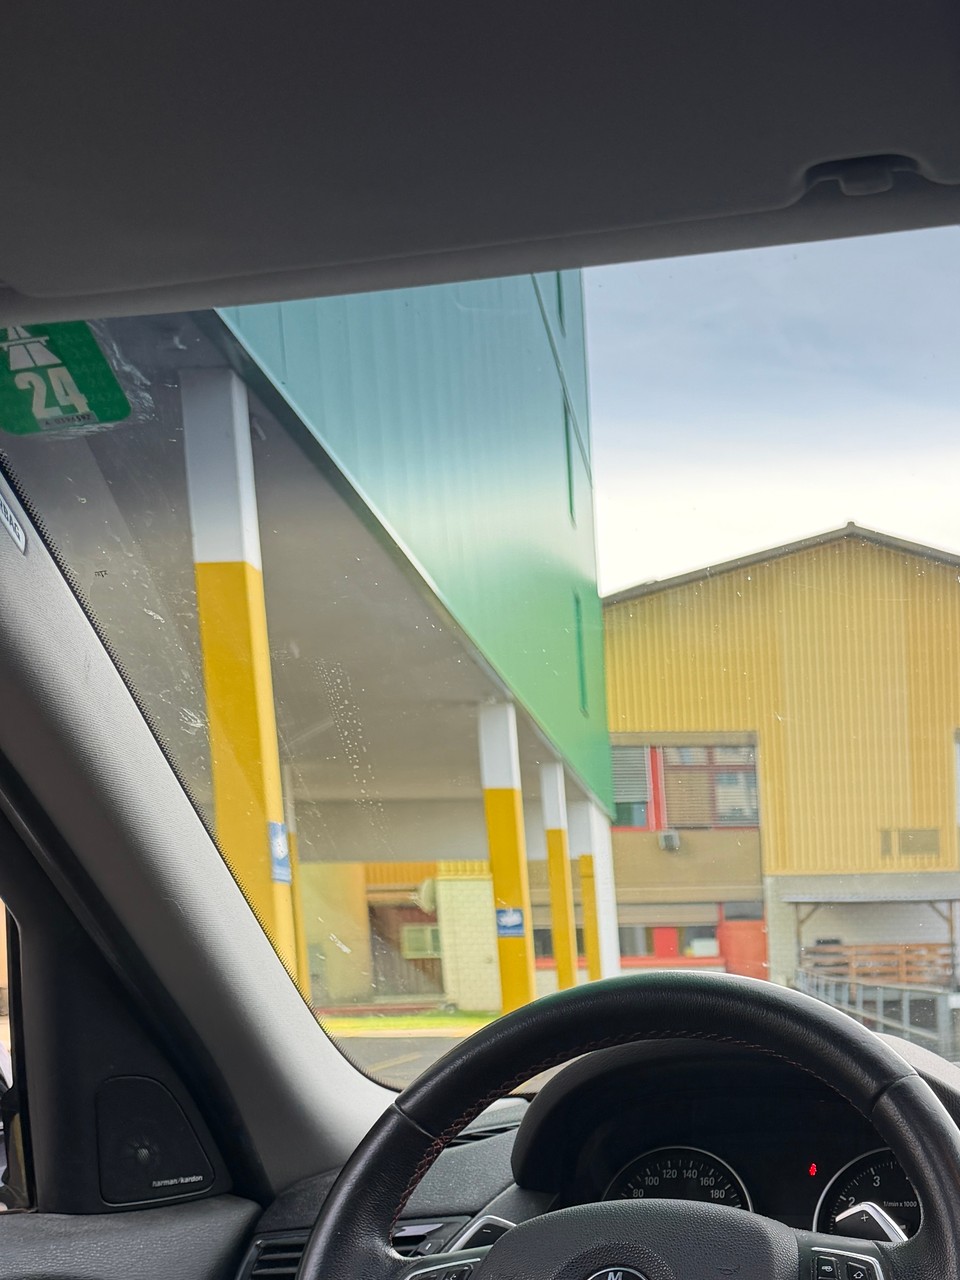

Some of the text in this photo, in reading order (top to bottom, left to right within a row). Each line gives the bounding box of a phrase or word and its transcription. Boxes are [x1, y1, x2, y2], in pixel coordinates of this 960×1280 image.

[14, 367, 89, 419] 24
[662, 1169, 697, 1178] 120 140
[152, 1175, 203, 1187] harman/kardon
[644, 1176, 659, 1186] 100
[700, 1177, 715, 1186] 160
[873, 1175, 880, 1187] 3
[632, 1188, 644, 1198] 80
[710, 1189, 725, 1199] 180
[848, 1196, 856, 1207] 2
[904, 1200, 917, 1208] 1000
